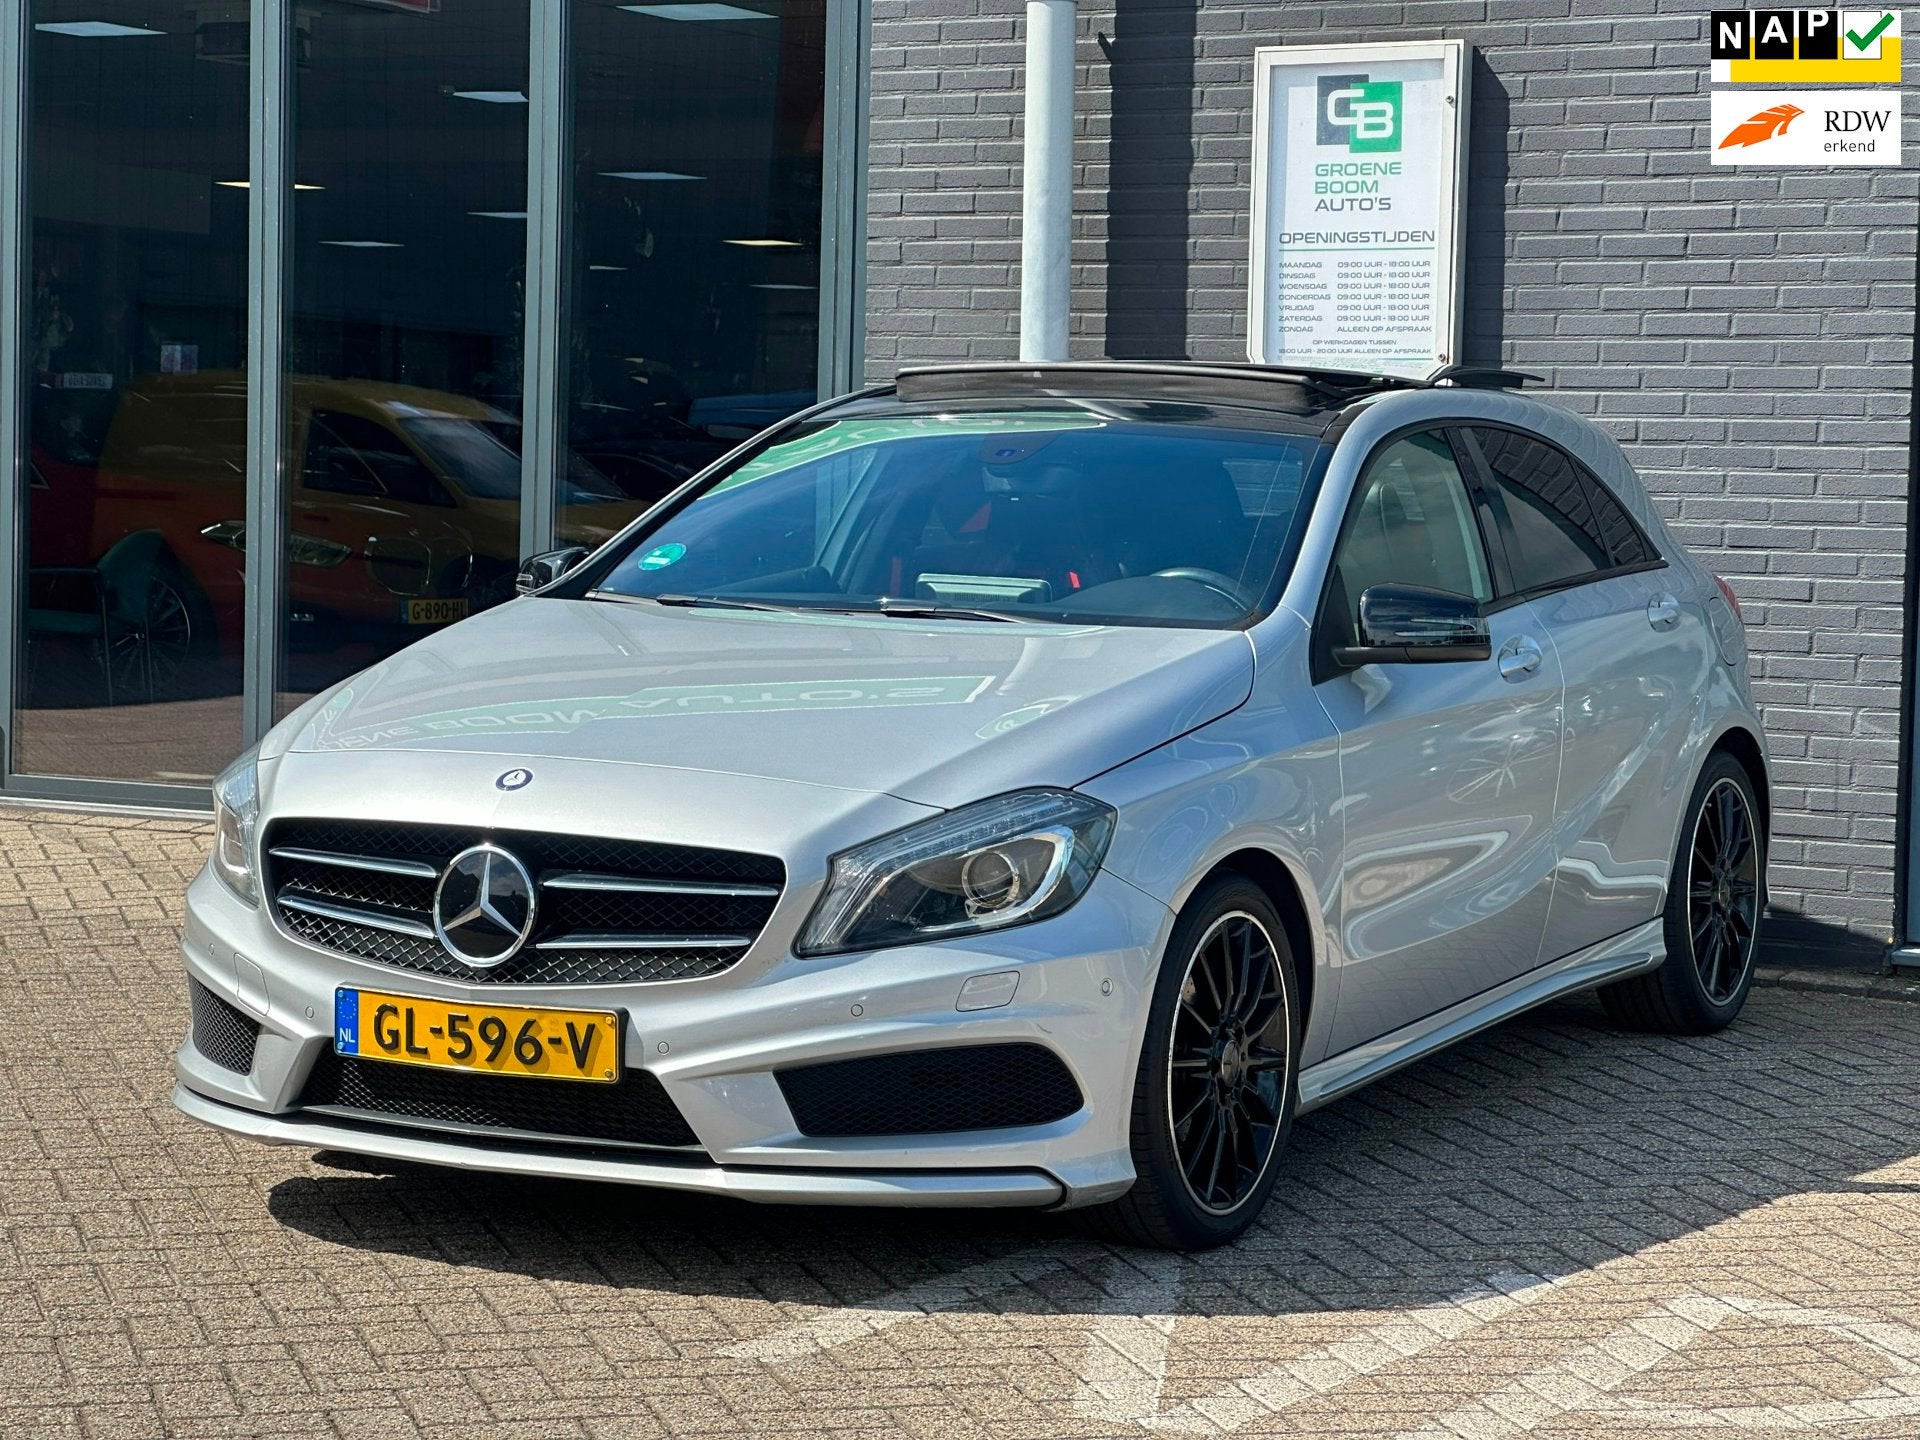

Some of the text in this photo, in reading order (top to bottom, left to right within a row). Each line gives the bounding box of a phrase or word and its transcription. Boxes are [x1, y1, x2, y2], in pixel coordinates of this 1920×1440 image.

[1315, 162, 1402, 177] GROENE
[1315, 180, 1379, 194] BOOM
[1315, 197, 1391, 212] AUTO'S
[1279, 230, 1435, 244] OPENINGSTIJDEN
[339, 1028, 355, 1043] NL
[373, 1003, 596, 1069] GL-596-V
